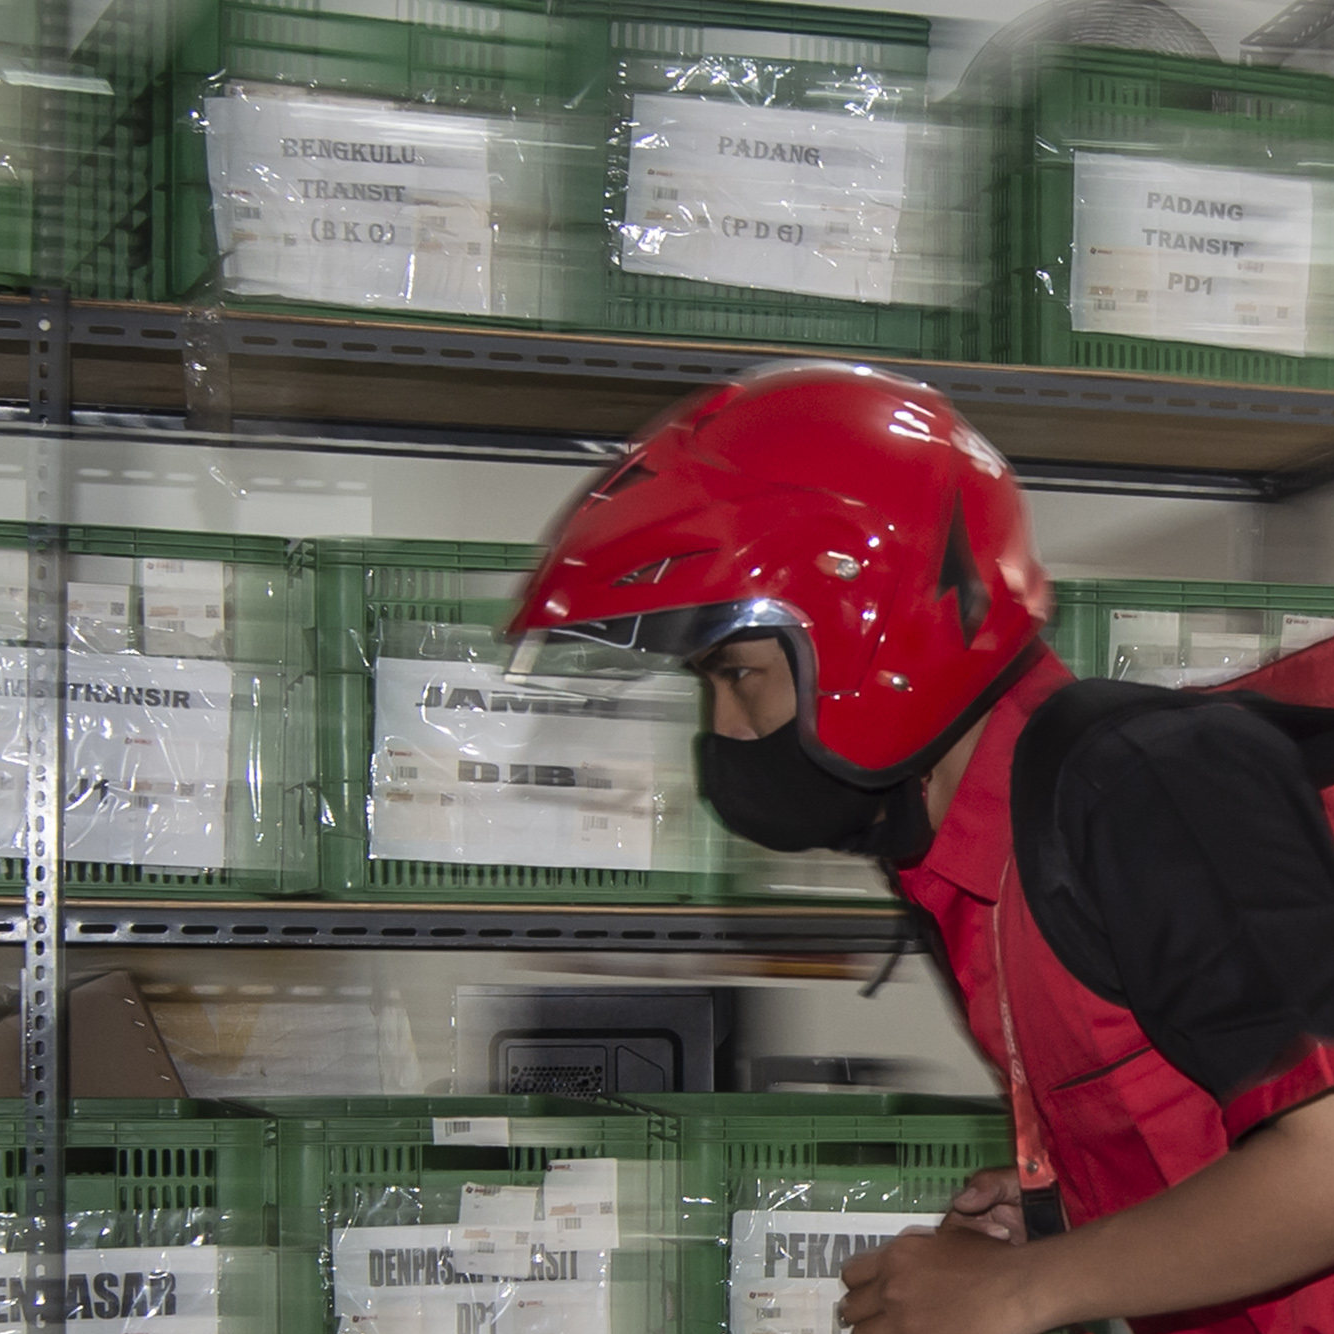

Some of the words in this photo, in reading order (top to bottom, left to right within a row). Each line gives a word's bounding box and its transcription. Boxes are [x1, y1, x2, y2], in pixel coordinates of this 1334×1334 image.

[281, 138, 417, 164] BENGKULU
[718, 136, 821, 165] PADANG
[298, 178, 405, 201] TRANSIT
[1146, 191, 1244, 222] PADANG
[1142, 228, 1244, 258] TRANSIT
[1167, 271, 1214, 296] PD1
[69, 682, 191, 709] TRANSIR
[369, 1245, 483, 1288] DENPAS
